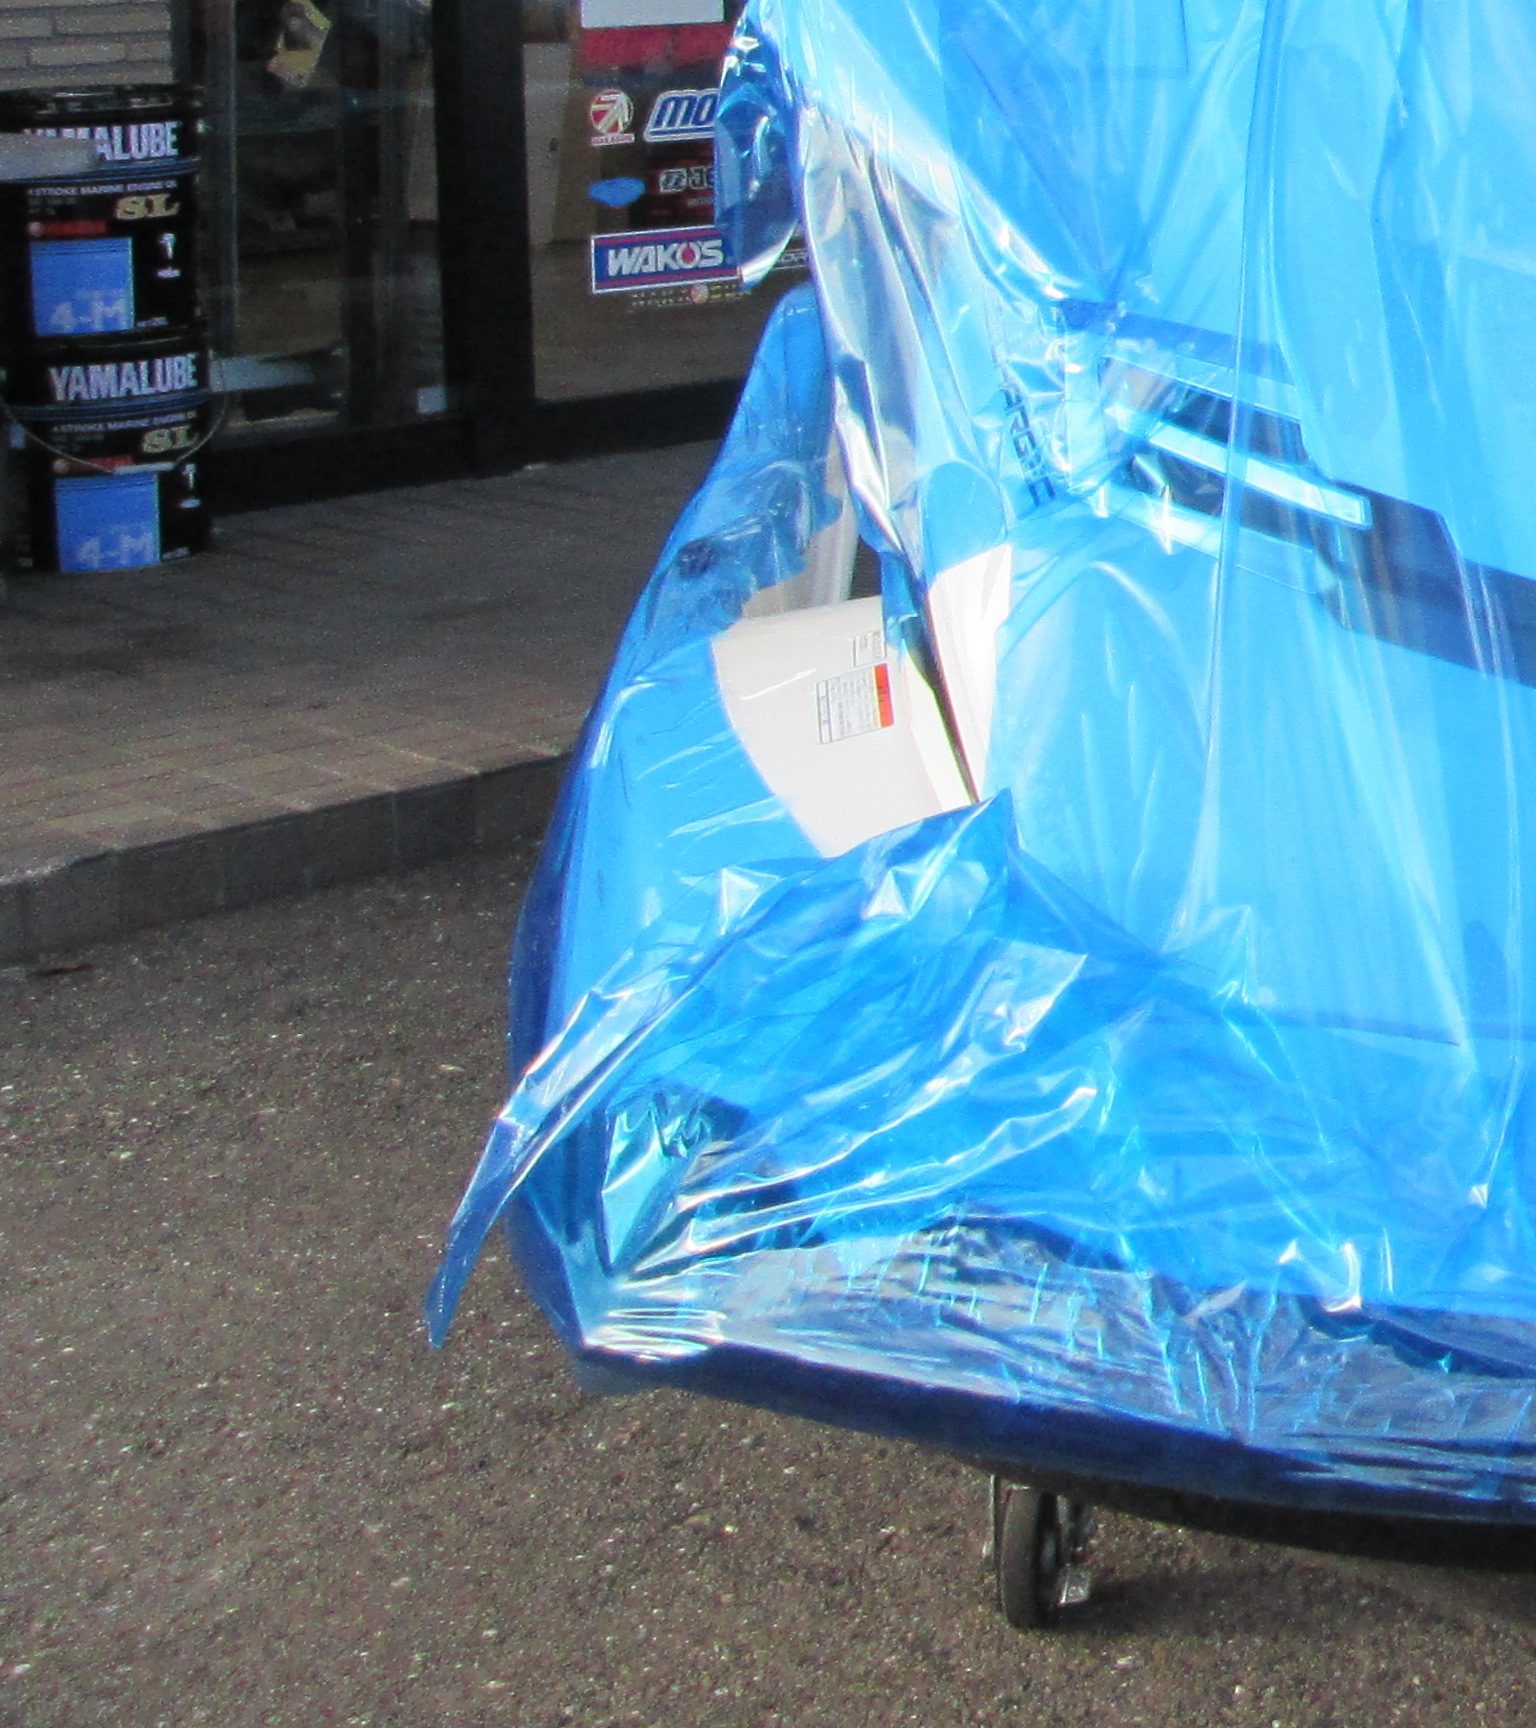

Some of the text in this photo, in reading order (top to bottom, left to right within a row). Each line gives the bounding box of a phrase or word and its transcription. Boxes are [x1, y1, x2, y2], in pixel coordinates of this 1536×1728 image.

[21, 120, 181, 162] ALUBE
[114, 193, 181, 221] SL
[49, 352, 199, 401] YAMALUBE
